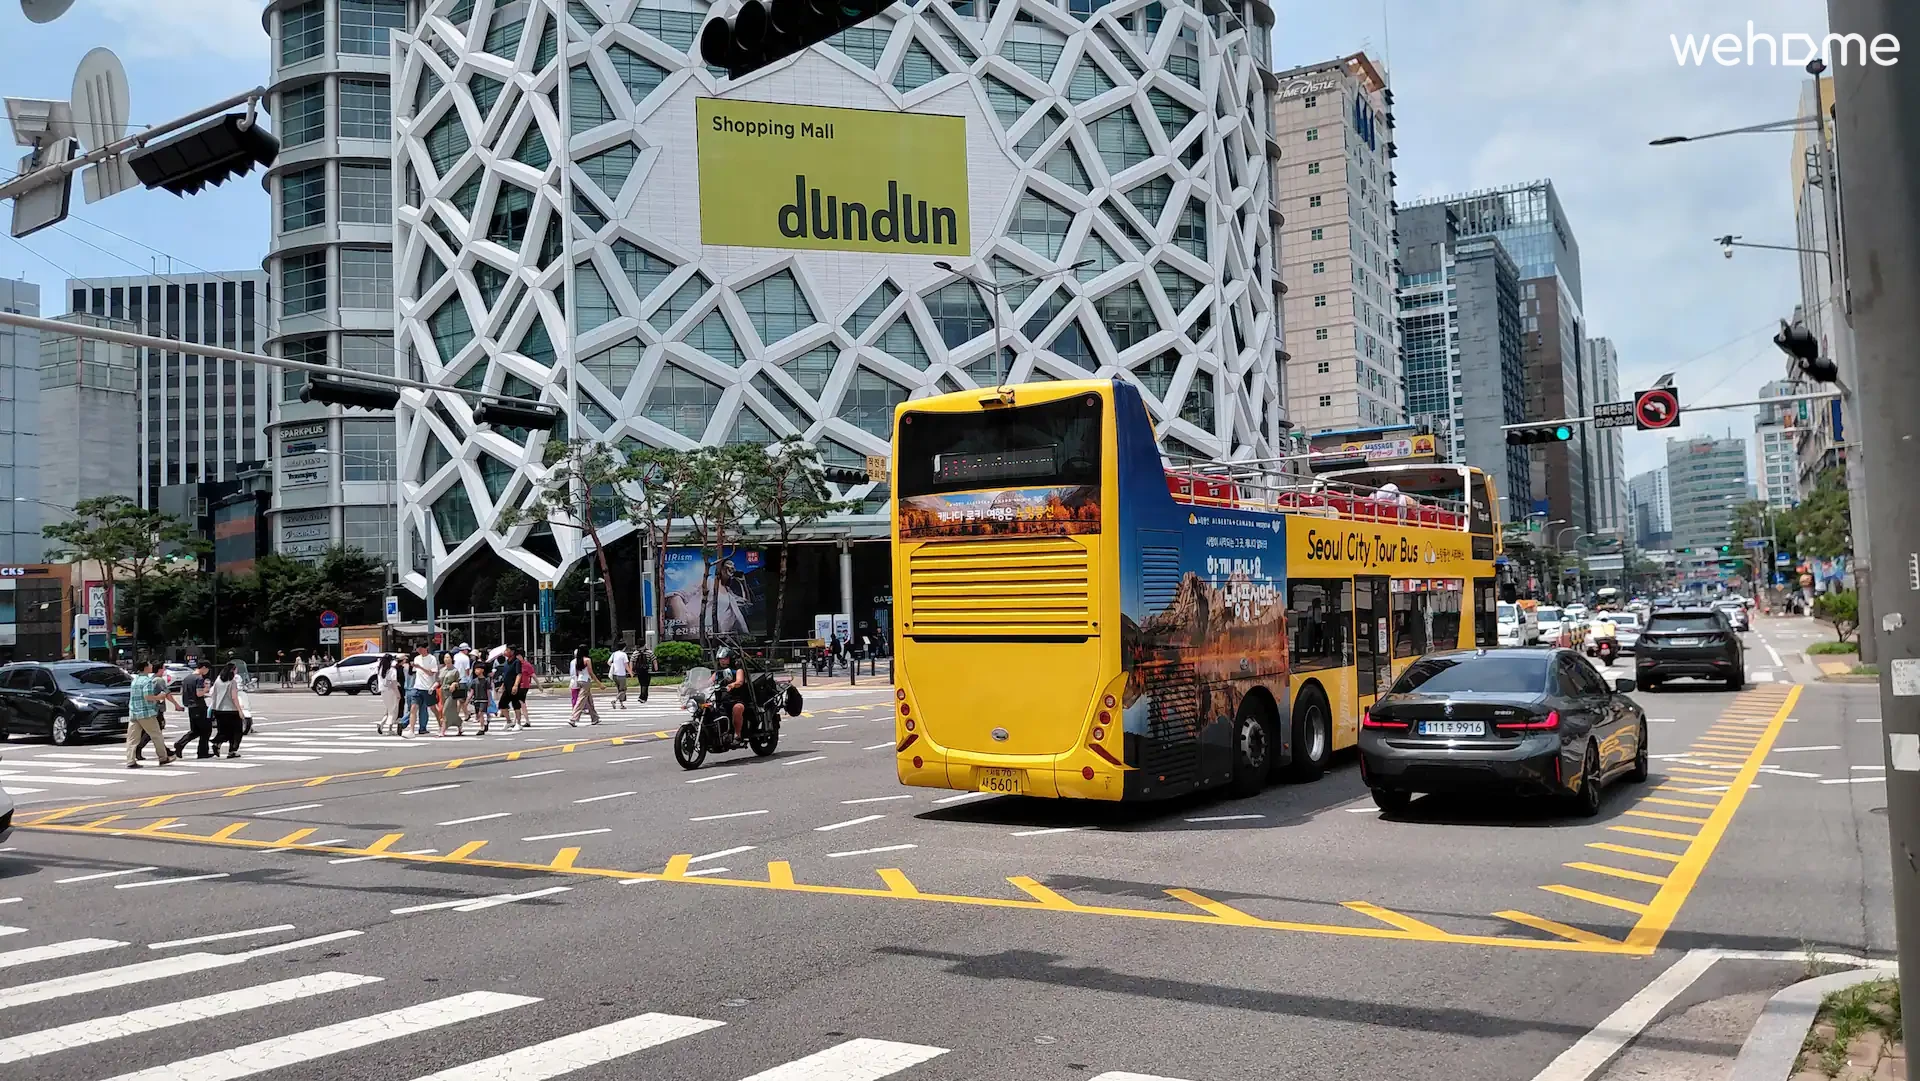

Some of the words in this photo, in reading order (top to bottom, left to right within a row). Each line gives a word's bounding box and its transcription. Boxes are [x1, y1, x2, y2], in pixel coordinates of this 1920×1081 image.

[712, 116, 795, 139] Shopping
[801, 122, 834, 139] Mall
[778, 174, 957, 245] dundun
[280, 425, 323, 439] SPARKPLUS
[1365, 442, 1394, 450] MASSAGE
[937, 510, 964, 522] 캐나다
[965, 509, 984, 521] 로키
[986, 507, 1013, 521] 여행은
[1016, 504, 1054, 519] 노랑풍선
[1307, 529, 1343, 561] Seoul
[1347, 532, 1371, 568] City
[1374, 534, 1398, 563] Tour
[1400, 536, 1419, 563] Bus
[80, 628, 87, 639] P
[1456, 722, 1482, 733] 9916
